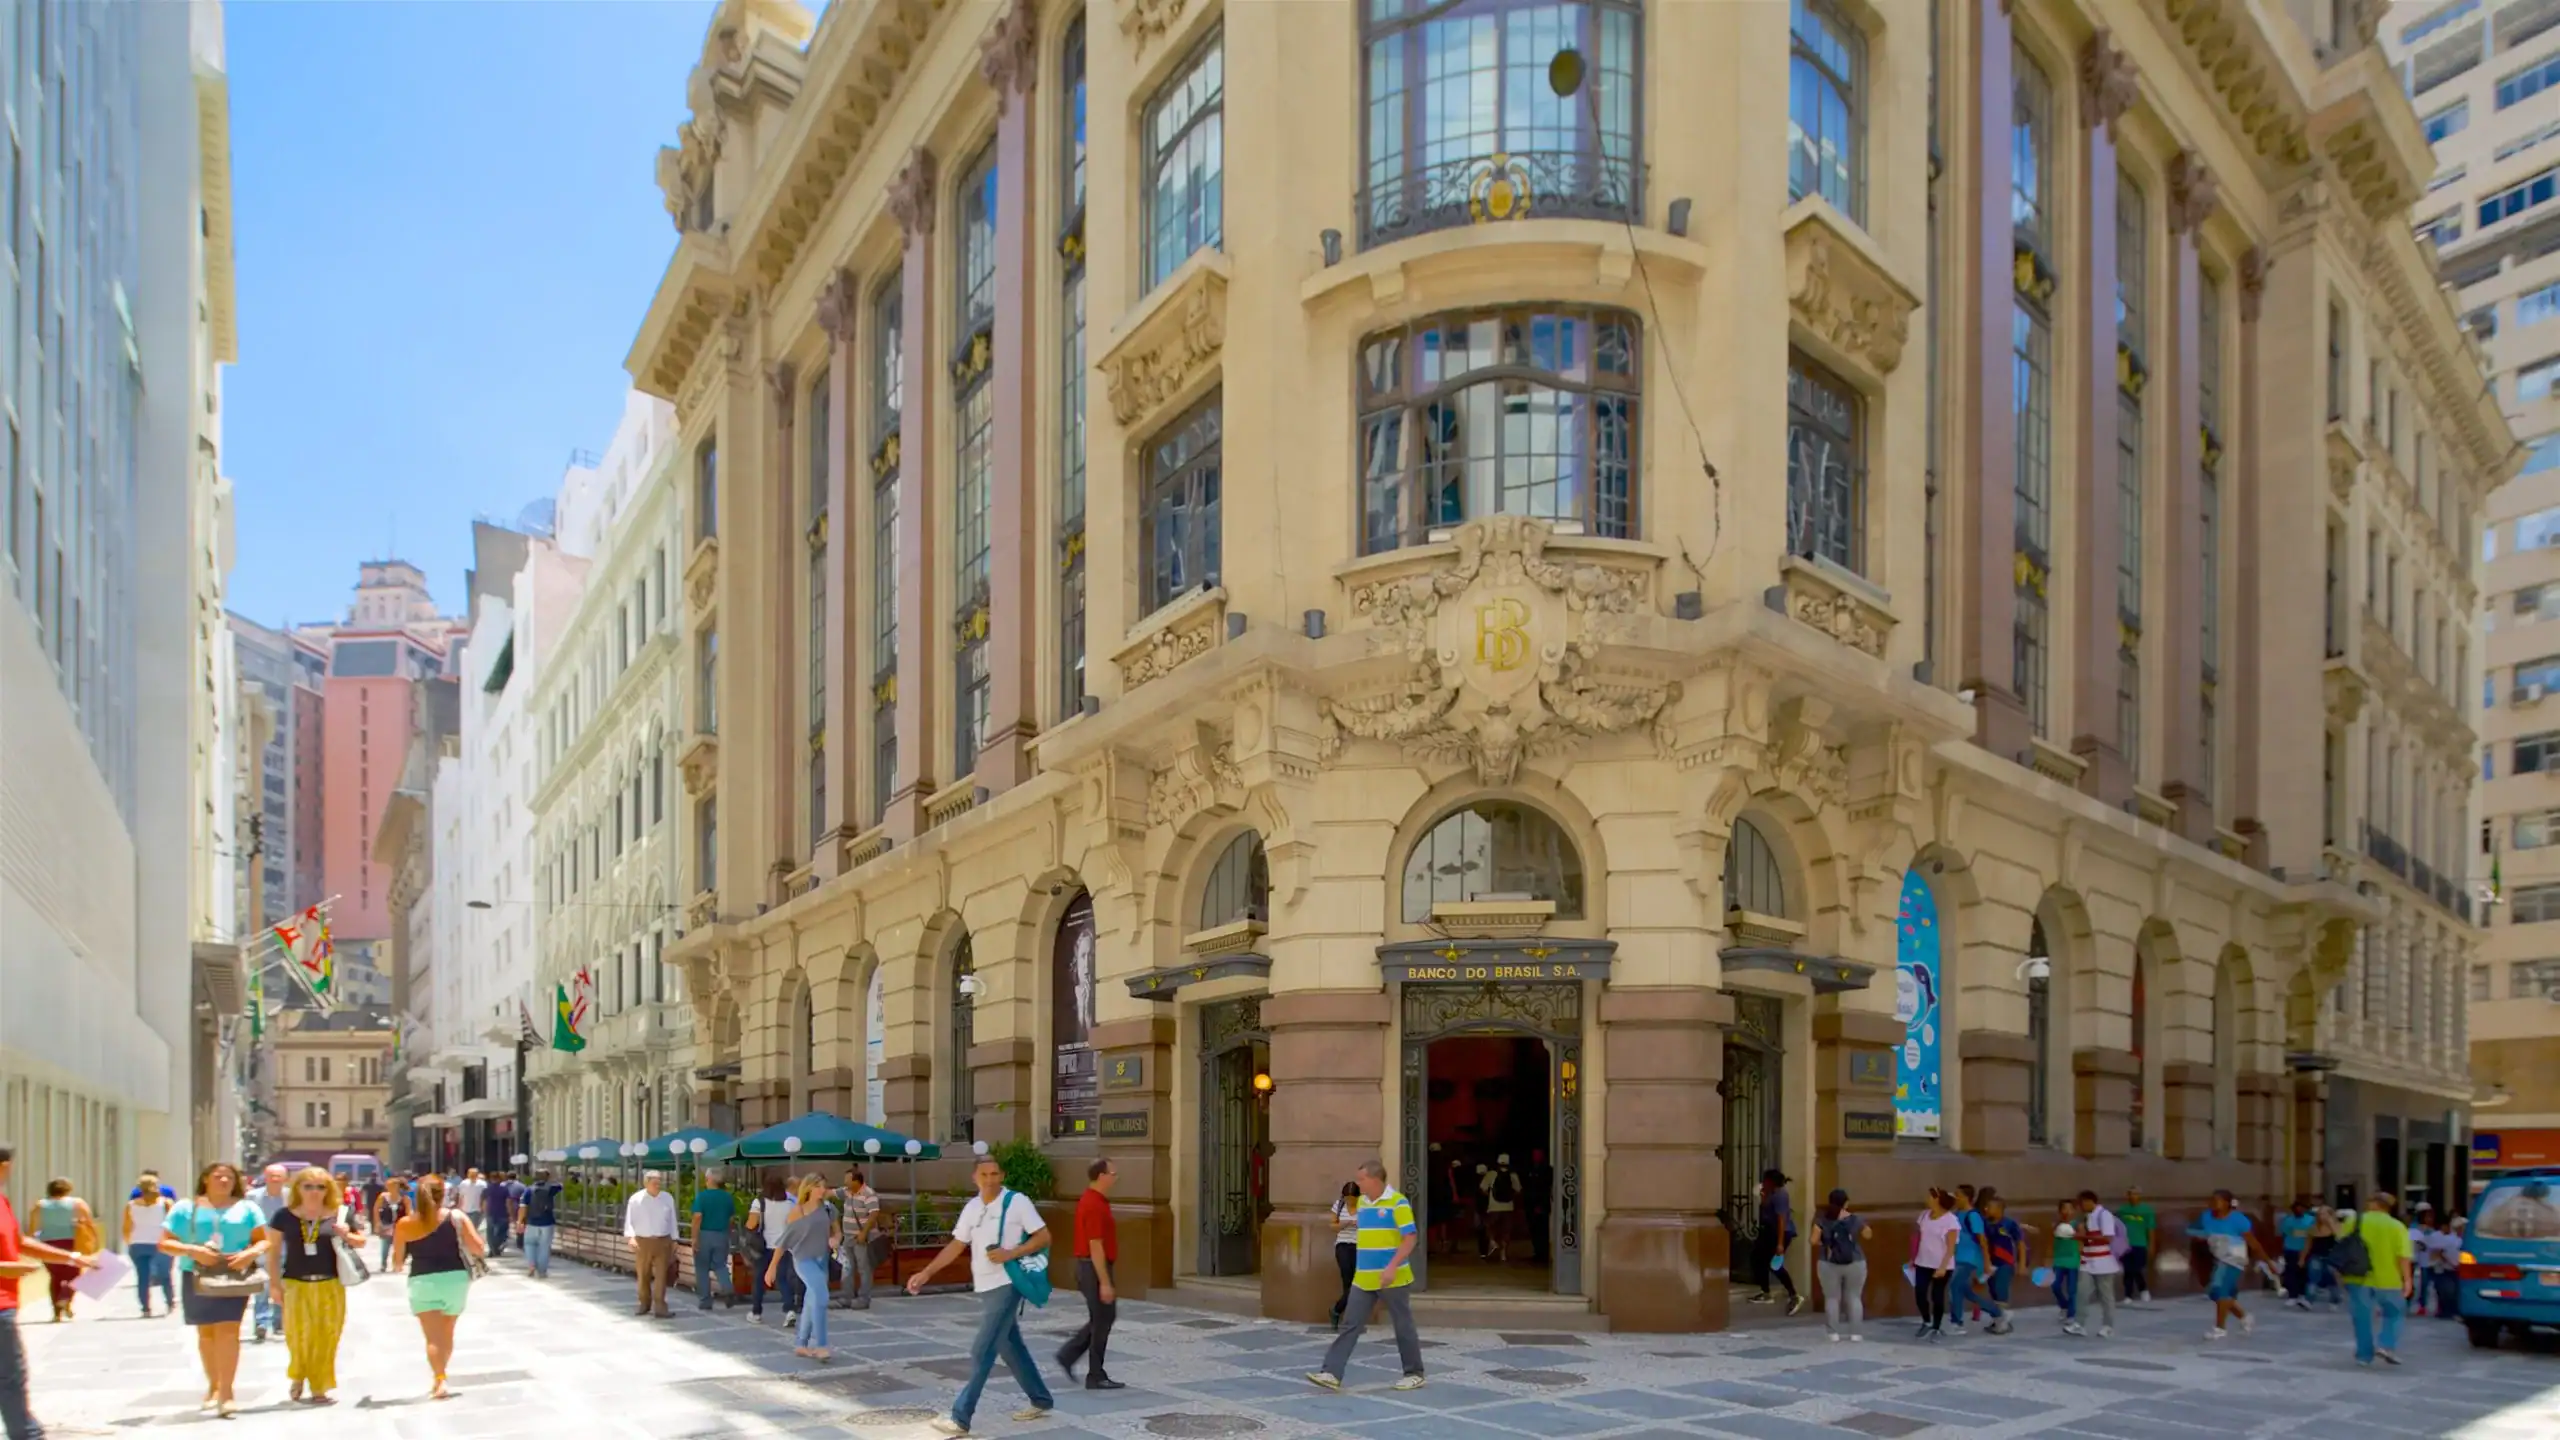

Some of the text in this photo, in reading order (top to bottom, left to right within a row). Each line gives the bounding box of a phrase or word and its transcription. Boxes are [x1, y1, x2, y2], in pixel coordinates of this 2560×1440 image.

[1408, 964, 1581, 979] BANCO DO BRASIL S.A.
